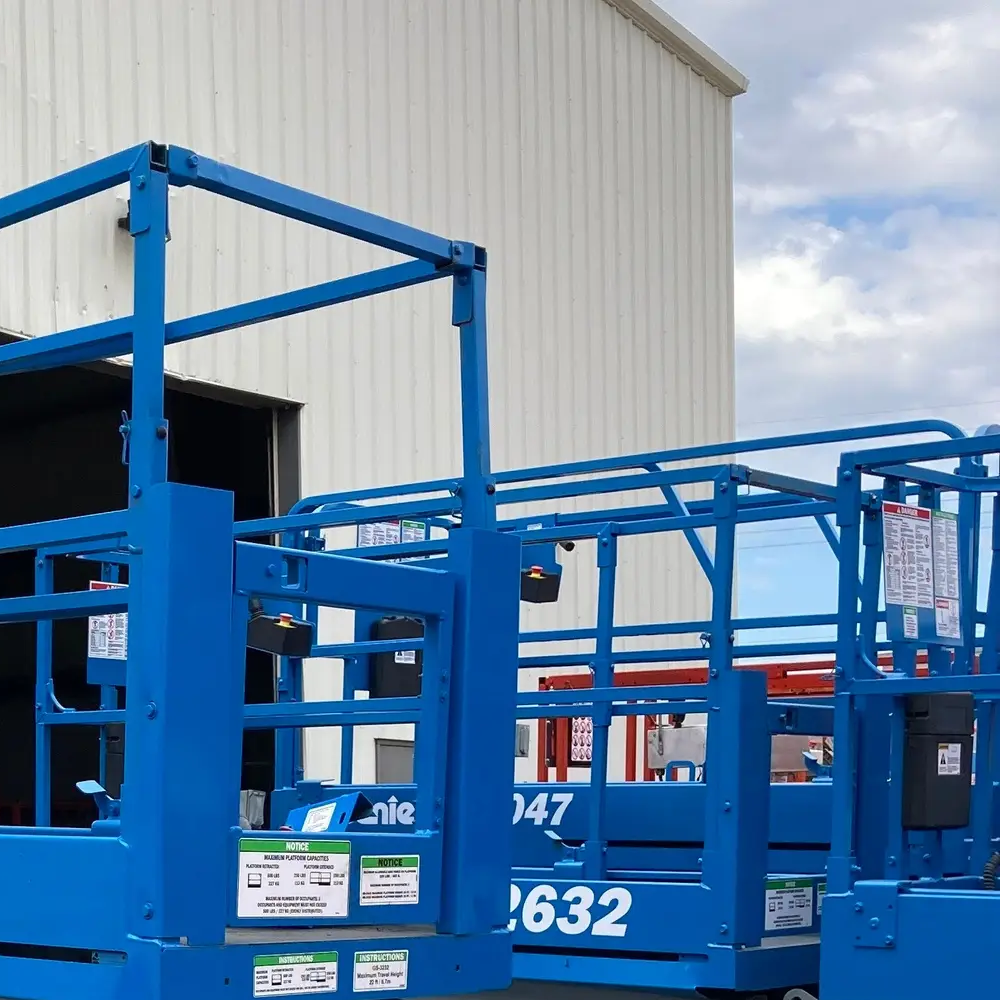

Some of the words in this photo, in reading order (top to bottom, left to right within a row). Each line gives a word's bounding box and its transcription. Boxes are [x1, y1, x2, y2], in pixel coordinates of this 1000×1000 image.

[285, 842, 310, 851] NOTICE
[378, 858, 403, 867] NOTICE
[278, 954, 314, 964] INSTRUCTIONS
[359, 952, 405, 962] INSTRUCTIONS
